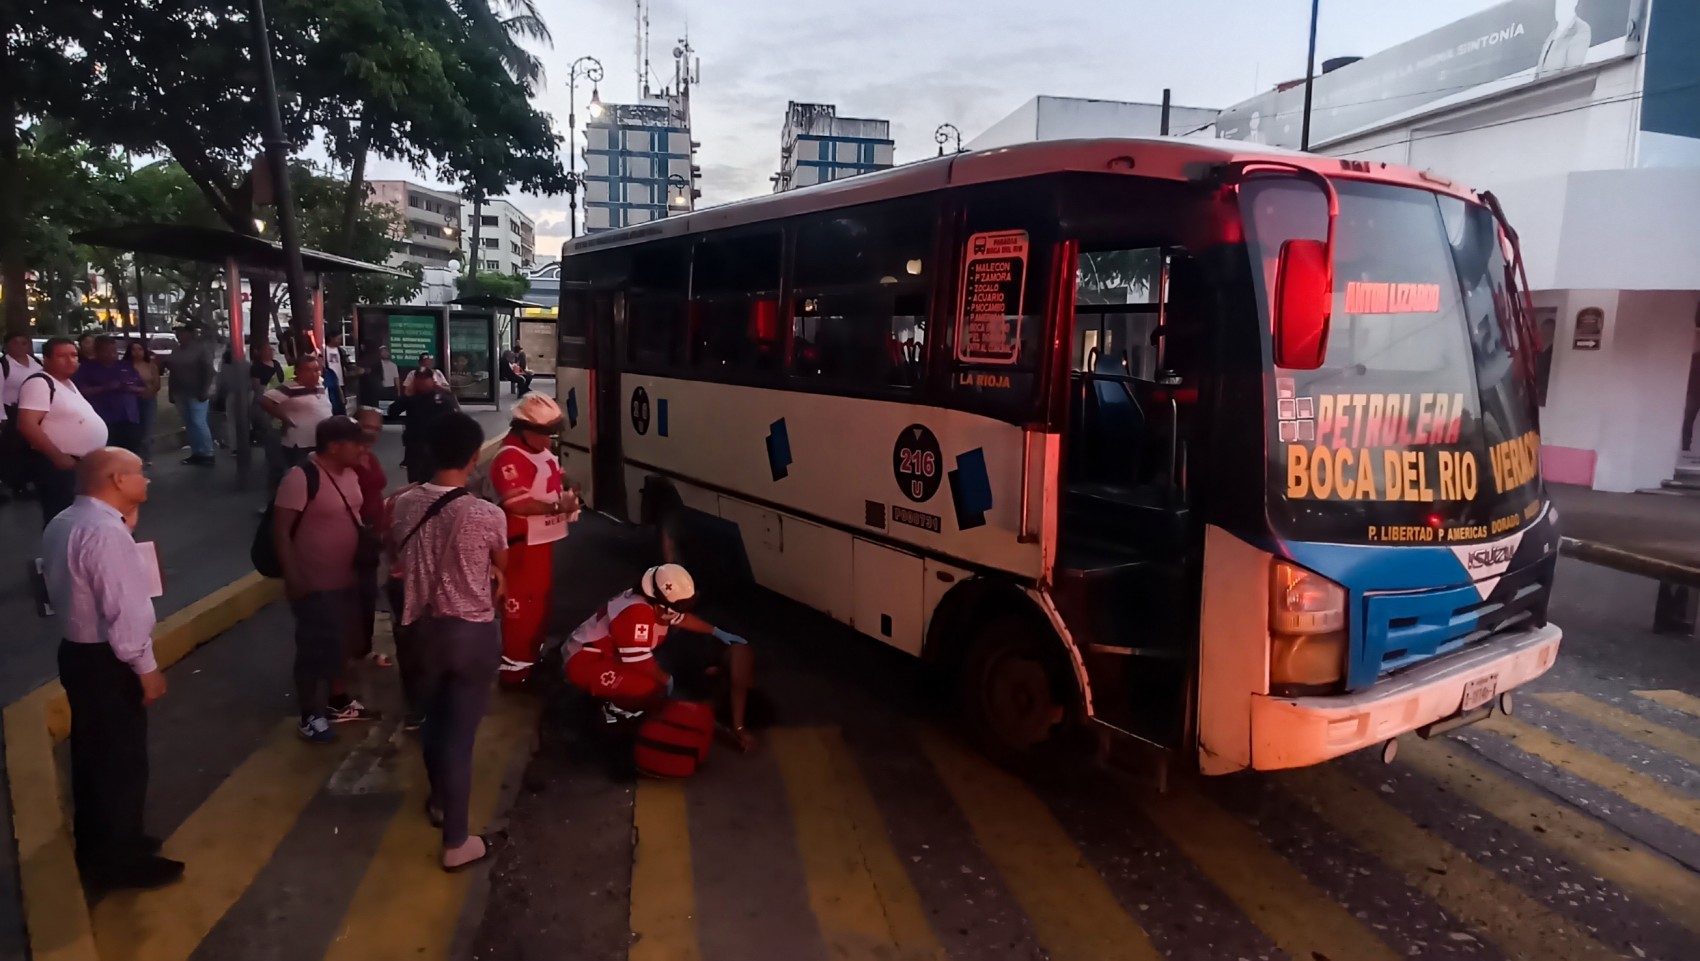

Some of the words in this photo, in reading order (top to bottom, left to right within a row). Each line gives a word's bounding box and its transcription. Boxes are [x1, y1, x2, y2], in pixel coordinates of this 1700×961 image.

[1457, 23, 1525, 56] SINTONÍA
[975, 262, 1011, 273] MALECON
[980, 272, 1012, 282] ZAMORA
[974, 284, 999, 293] ZOCALO
[972, 293, 1005, 302] ACUARIO
[960, 373, 973, 385] LA
[976, 374, 1010, 388] RIOJA
[1316, 393, 1464, 450] PETROLERA
[900, 447, 936, 477] 216
[1287, 444, 1377, 500] BOCA
[1384, 450, 1434, 502] DEL
[1438, 450, 1478, 501] RIO
[911, 480, 923, 498] U
[1368, 526, 1378, 541] P.
[1381, 526, 1434, 541] LIBERTAD
[1438, 528, 1445, 541] P
[1447, 525, 1487, 541] AMERICAS
[1467, 545, 1515, 570] ISUZU
